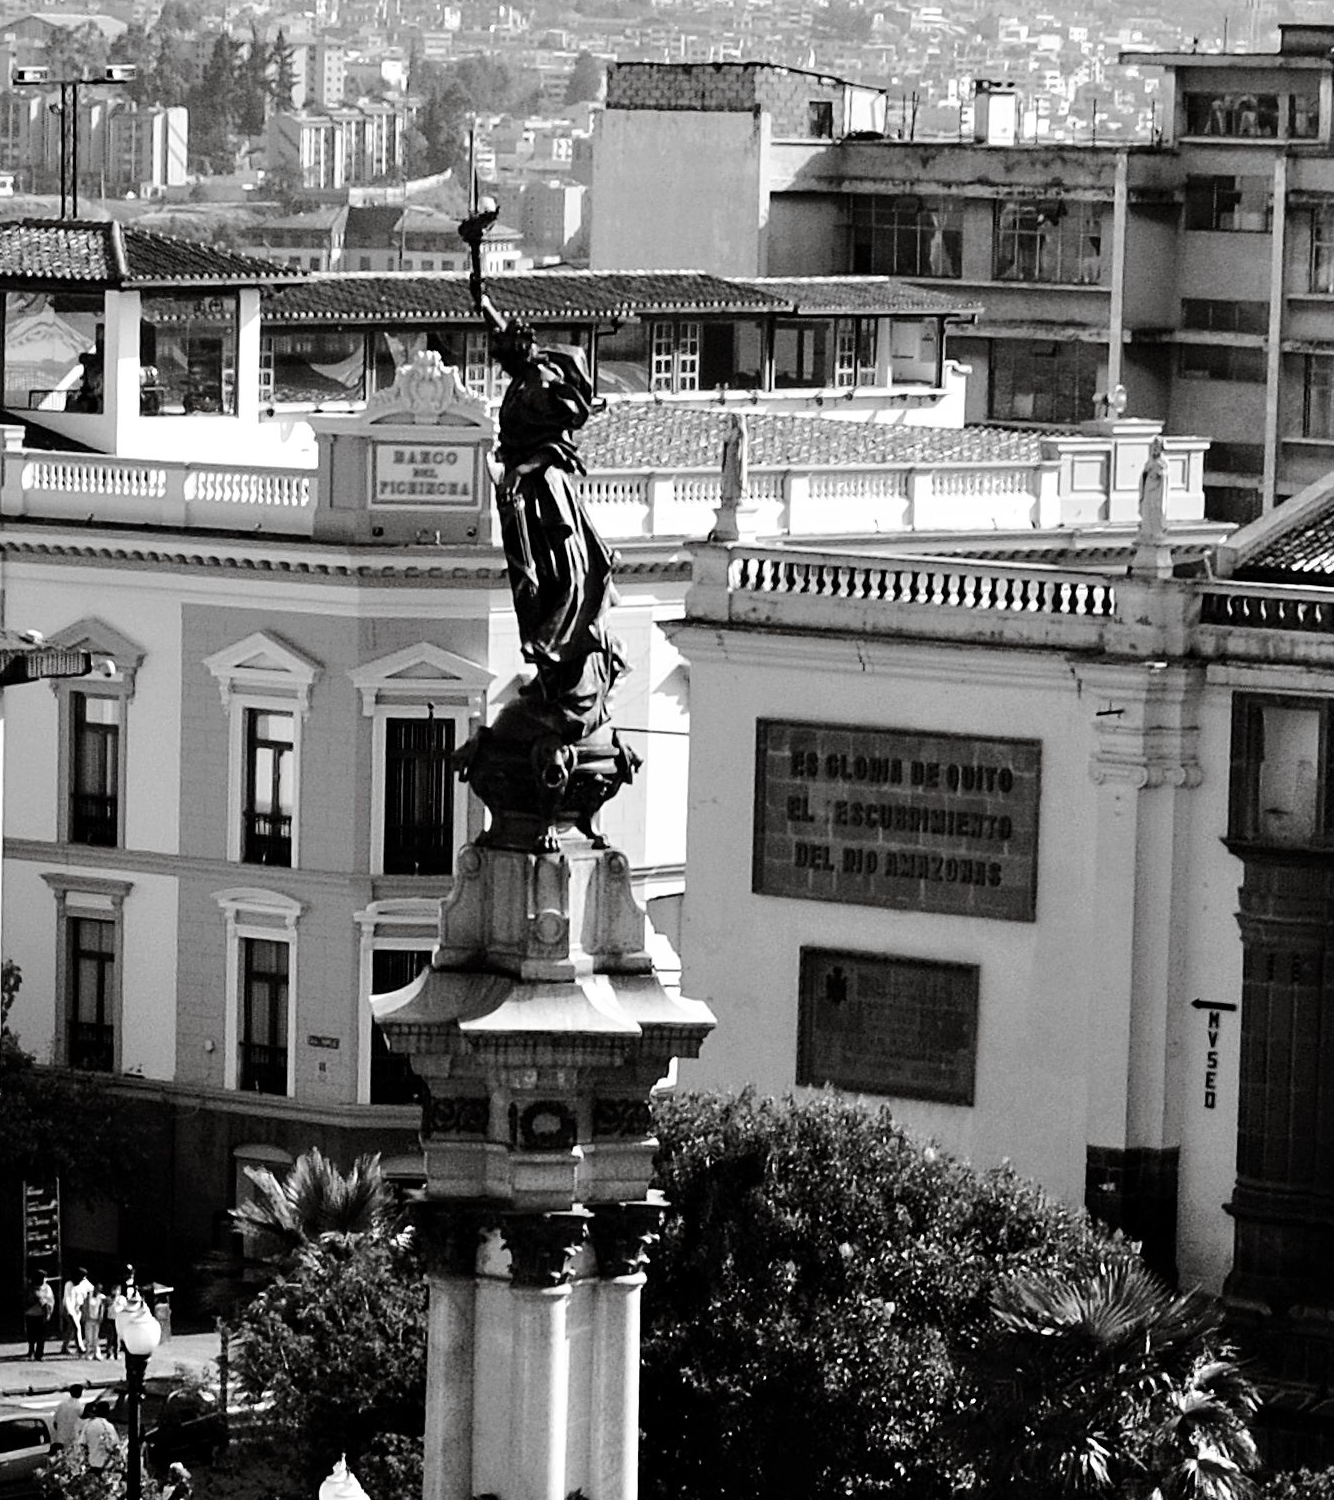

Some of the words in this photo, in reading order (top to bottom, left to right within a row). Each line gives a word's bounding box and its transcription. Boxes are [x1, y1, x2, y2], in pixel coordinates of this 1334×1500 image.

[393, 450, 458, 466] BANCO
[379, 481, 469, 496] PICHINCHA
[791, 751, 819, 778] ES
[825, 753, 903, 785] GLORIA
[911, 761, 940, 789] DE
[946, 763, 1014, 794] QUITO
[787, 795, 815, 823] EL
[823, 799, 1012, 841] ESCUBRIMIENTO
[794, 841, 835, 872] DEL
[842, 847, 878, 875] RIO
[884, 852, 1003, 887] AMAZONAS
